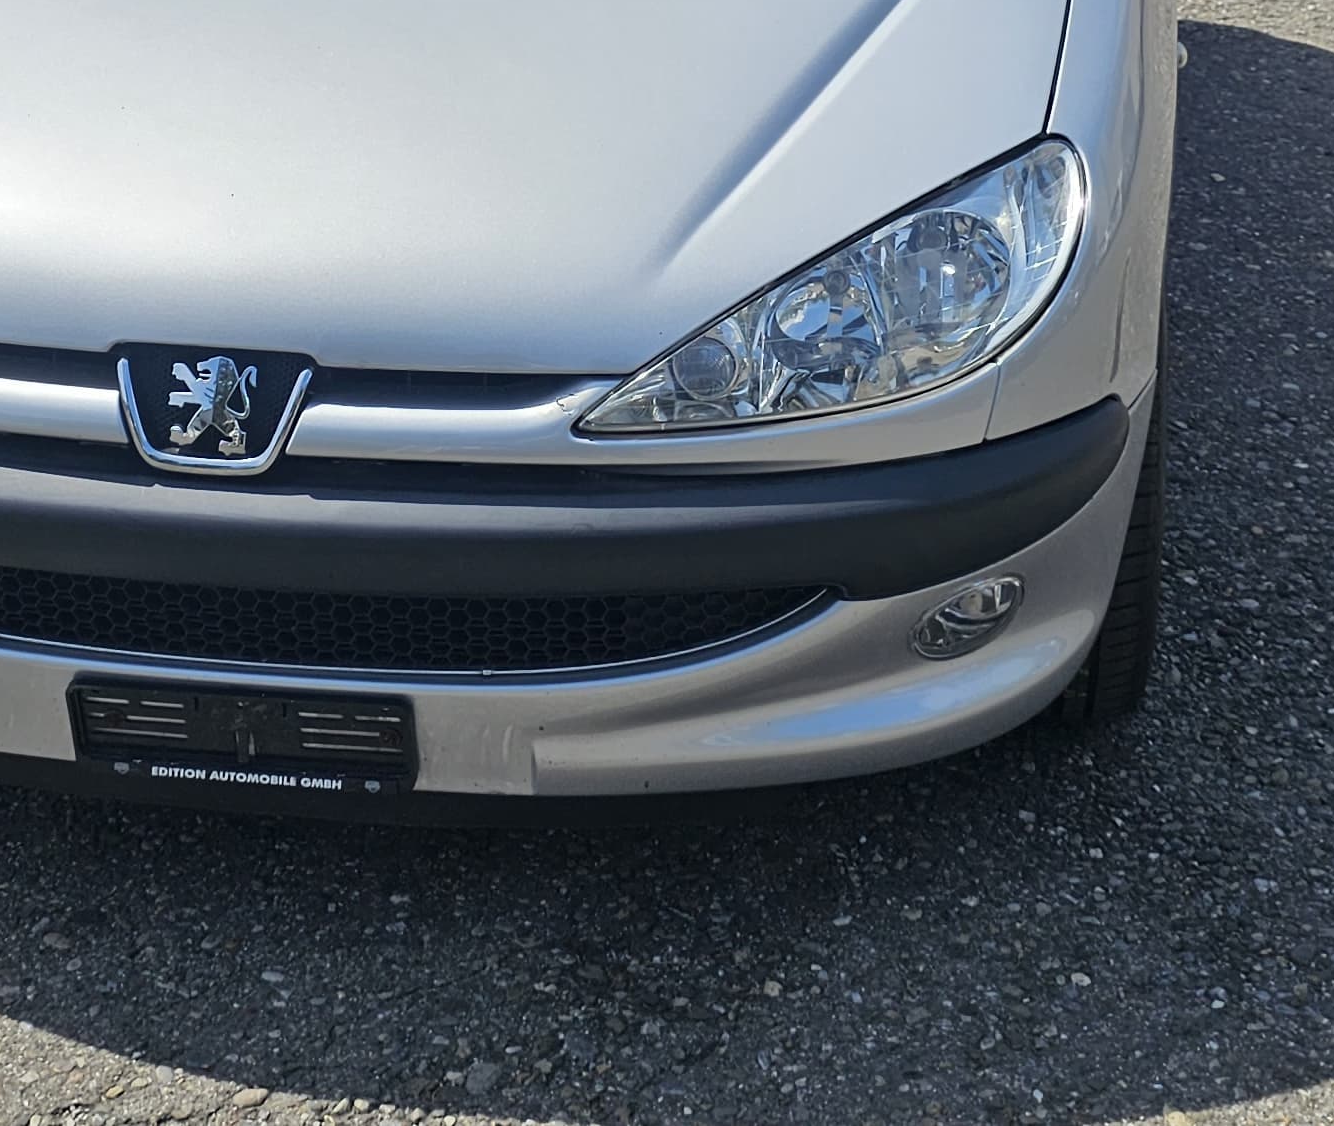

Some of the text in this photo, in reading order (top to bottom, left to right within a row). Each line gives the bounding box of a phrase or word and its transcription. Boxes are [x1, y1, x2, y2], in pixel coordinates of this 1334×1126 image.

[151, 766, 343, 790] EDITION AUTOMOBILE GMBH
